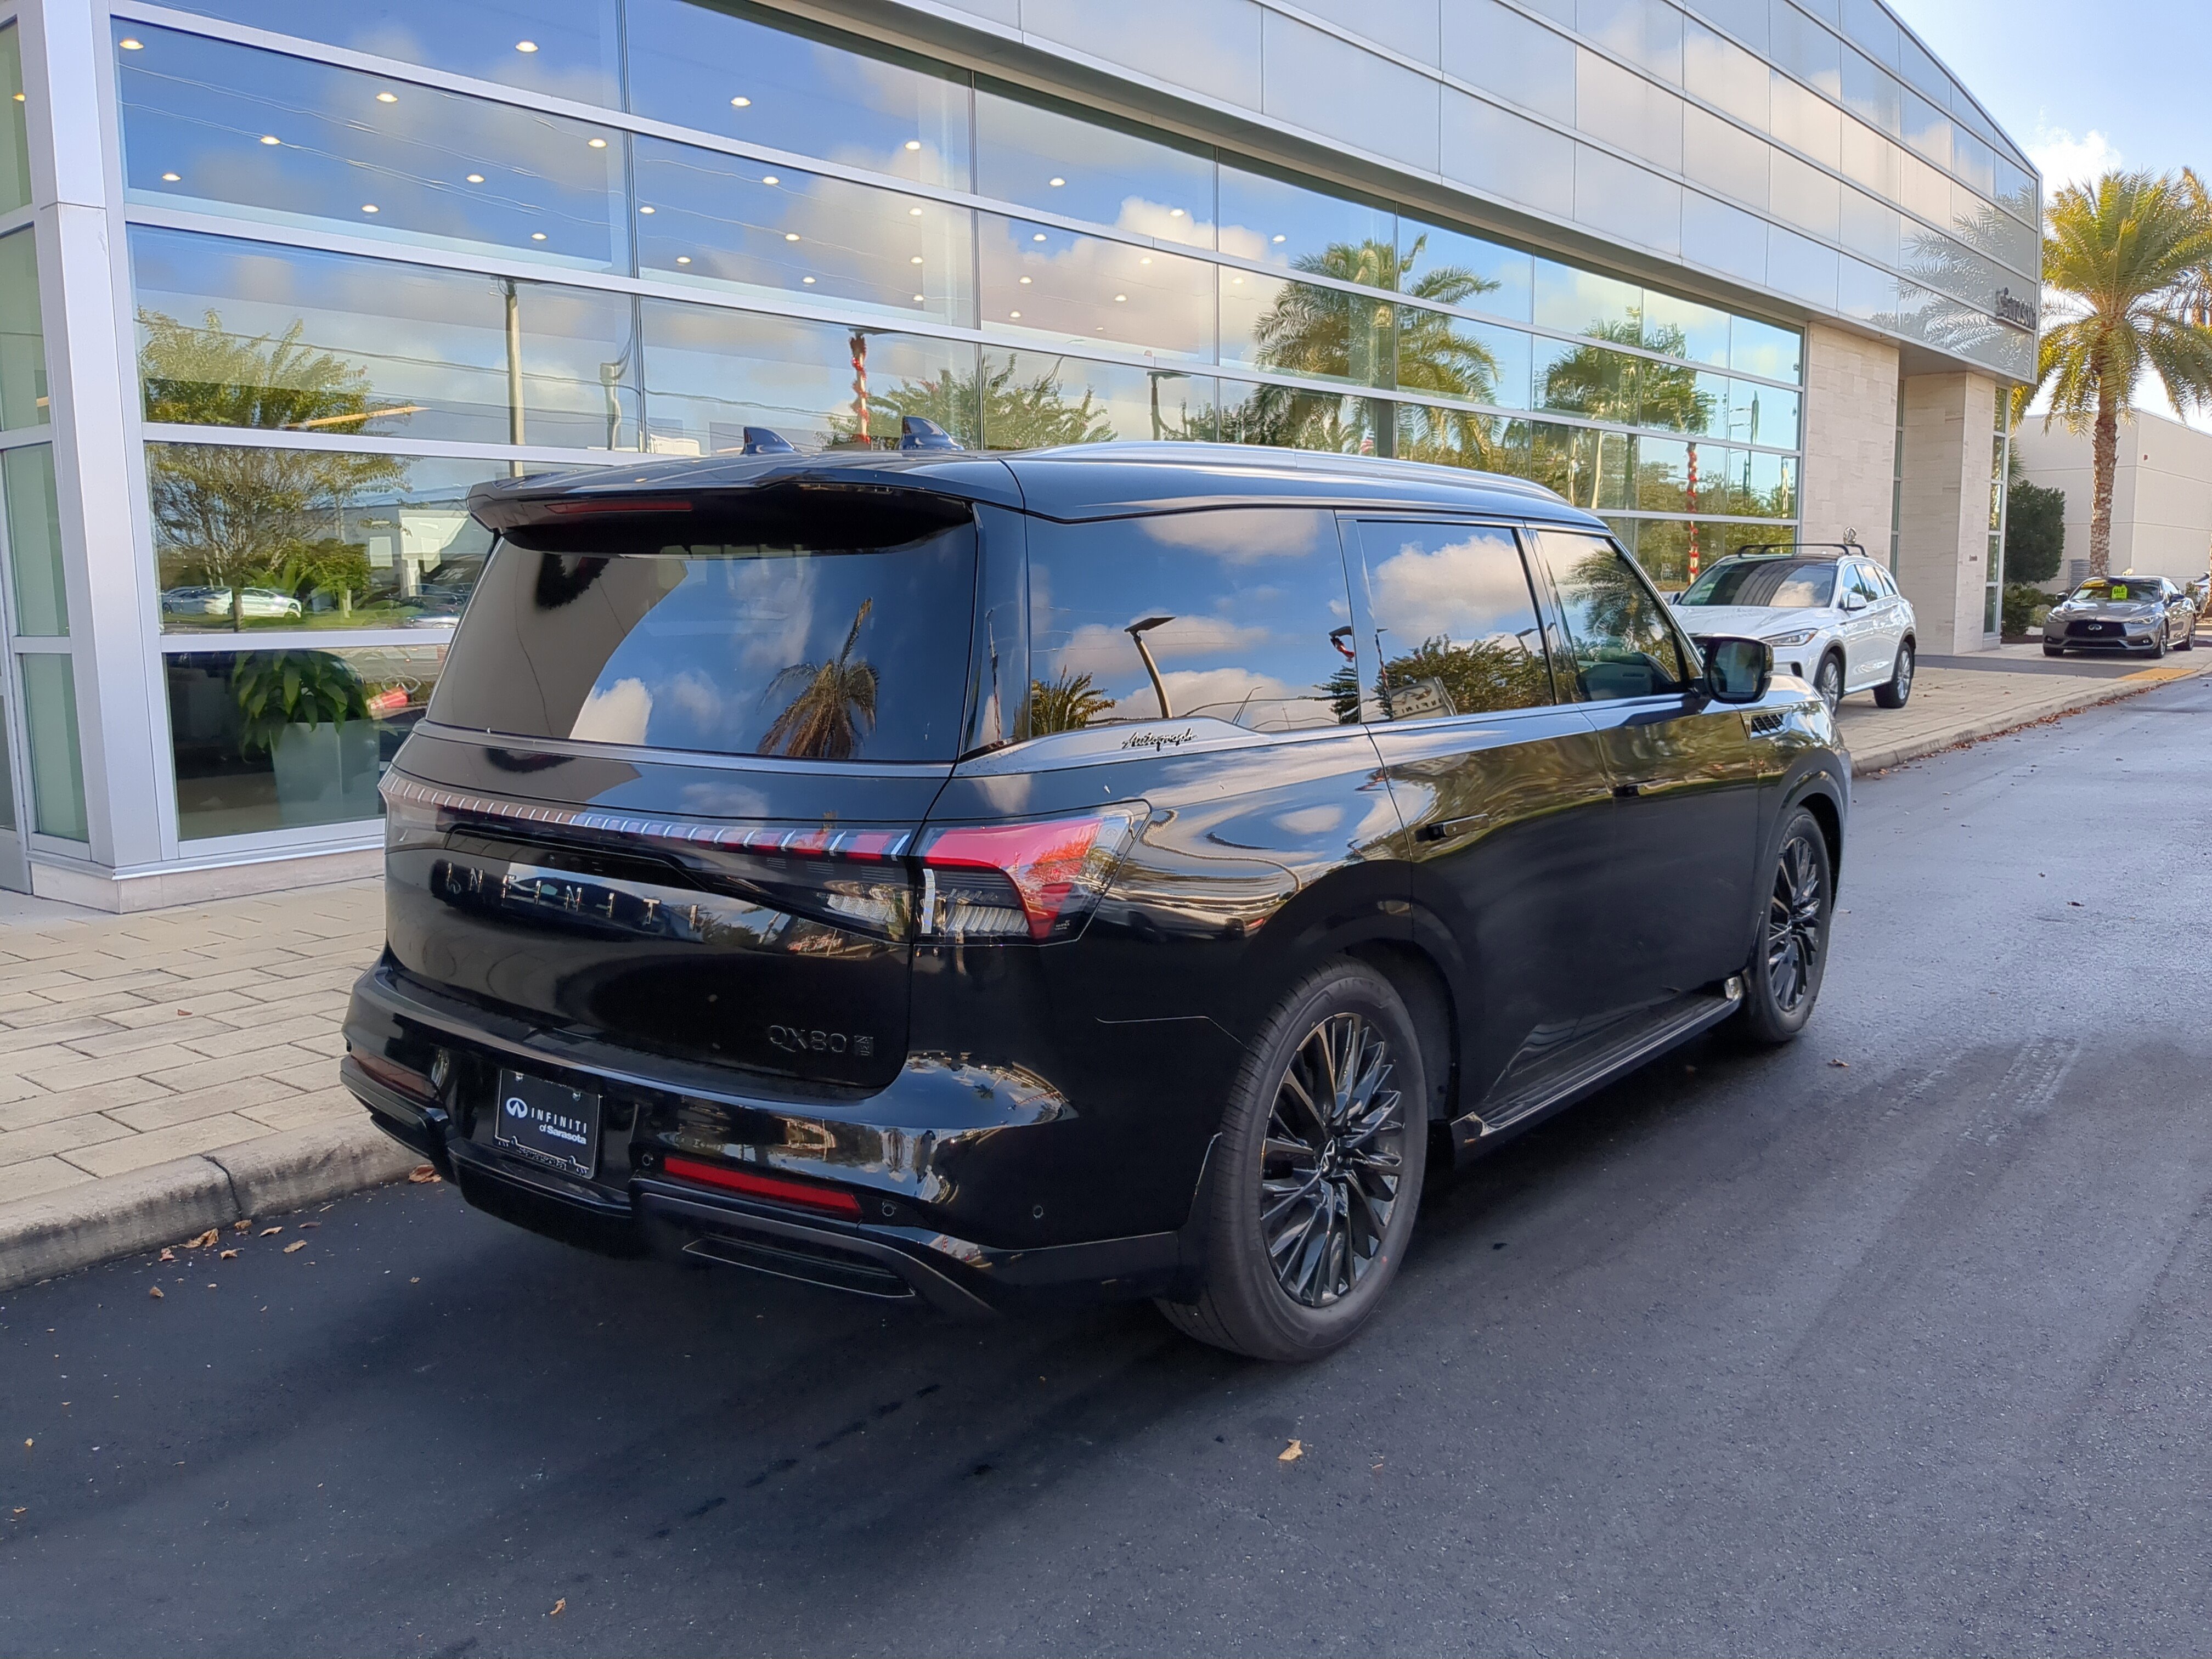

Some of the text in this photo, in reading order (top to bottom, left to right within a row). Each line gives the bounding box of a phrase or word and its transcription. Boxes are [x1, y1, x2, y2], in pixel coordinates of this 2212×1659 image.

[1122, 727, 1198, 752] Autograph
[446, 862, 698, 932] INFINITI
[769, 1025, 847, 1052] QX80
[531, 1107, 587, 1134] INFINITI
[539, 1124, 586, 1145] of Sarasota
